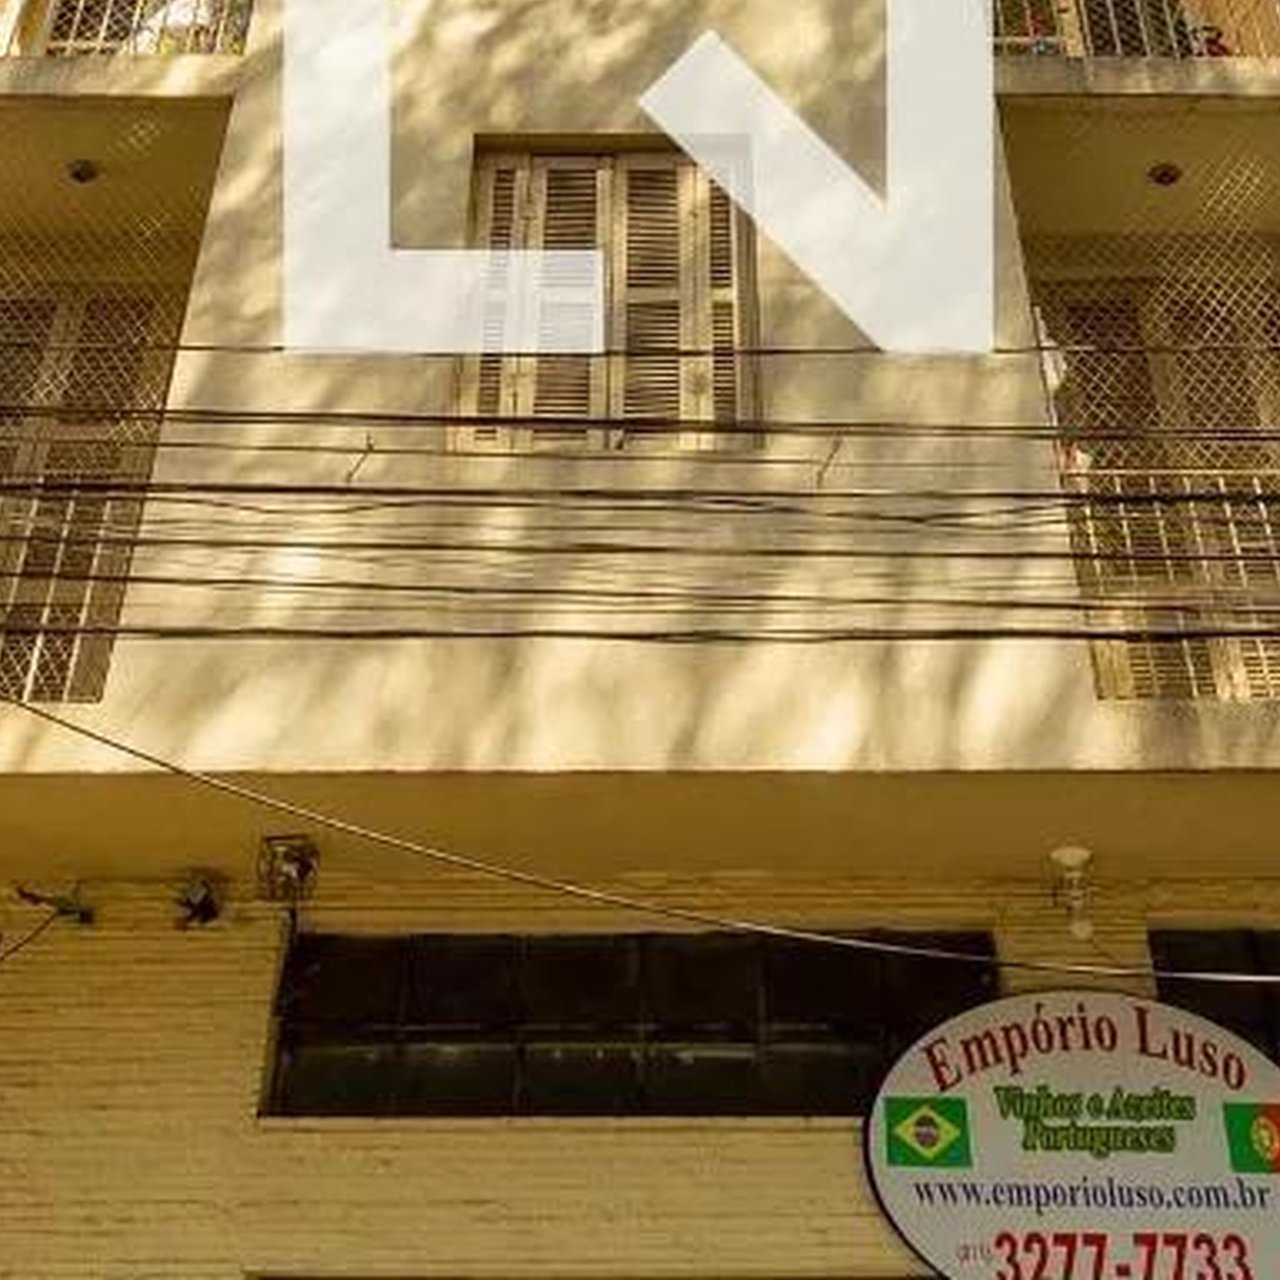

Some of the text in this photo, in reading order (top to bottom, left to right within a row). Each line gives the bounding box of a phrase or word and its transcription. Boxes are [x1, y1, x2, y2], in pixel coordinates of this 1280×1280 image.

[924, 1002, 1248, 1091] Empório Luso
[993, 1085, 1084, 1120] Vinhos
[1022, 1119, 1176, 1159] Portugueses
[914, 1176, 1273, 1215] www.emporioluso.com.br
[994, 1232, 1253, 1280] 3277-7733
